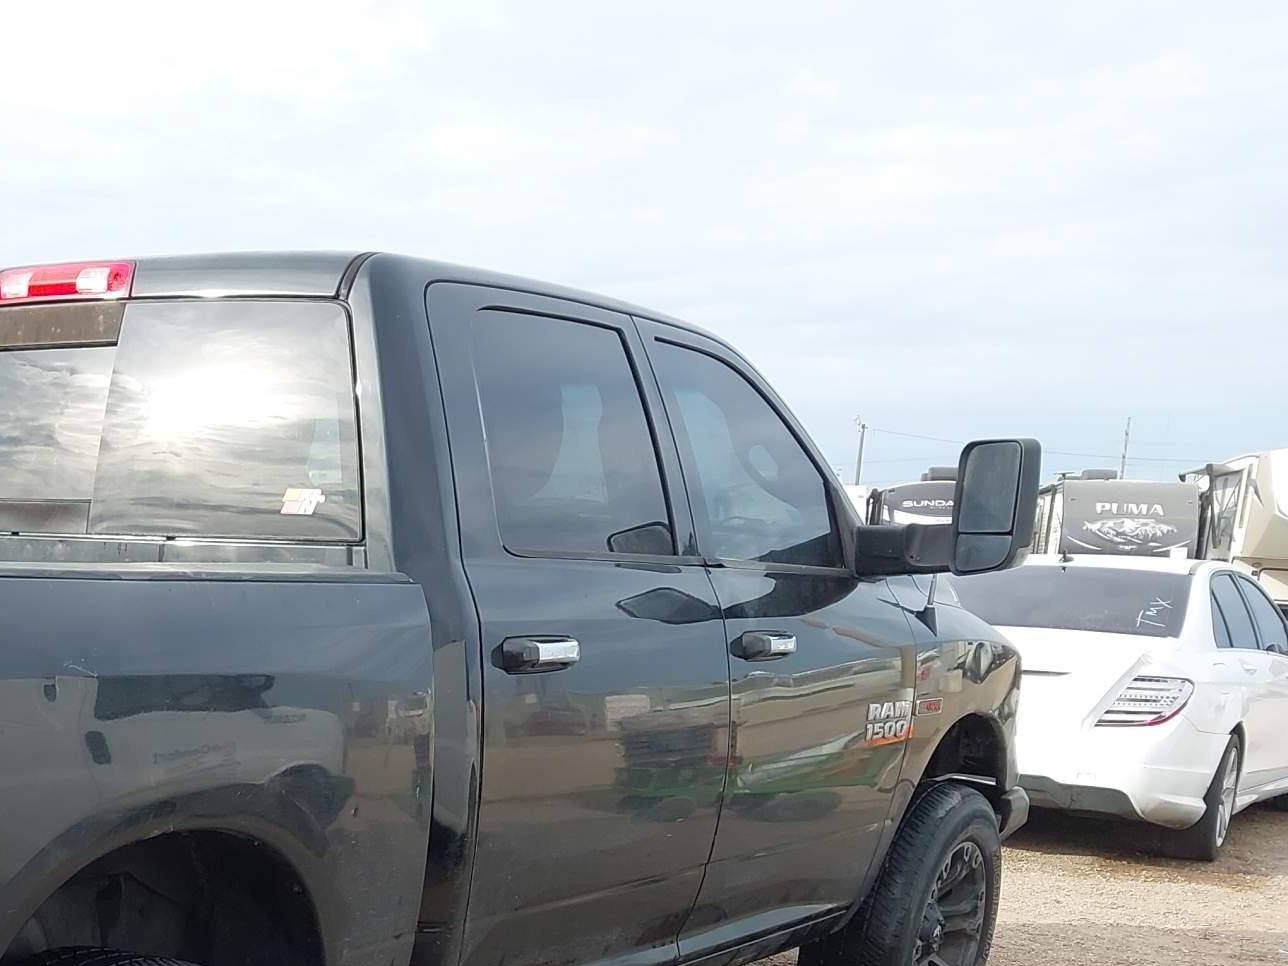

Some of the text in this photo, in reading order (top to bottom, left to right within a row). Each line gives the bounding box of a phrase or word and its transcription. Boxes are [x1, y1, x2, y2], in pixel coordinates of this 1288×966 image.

[1095, 502, 1165, 516] PUMA
[867, 701, 912, 721] RAM
[864, 720, 908, 743] 1500
